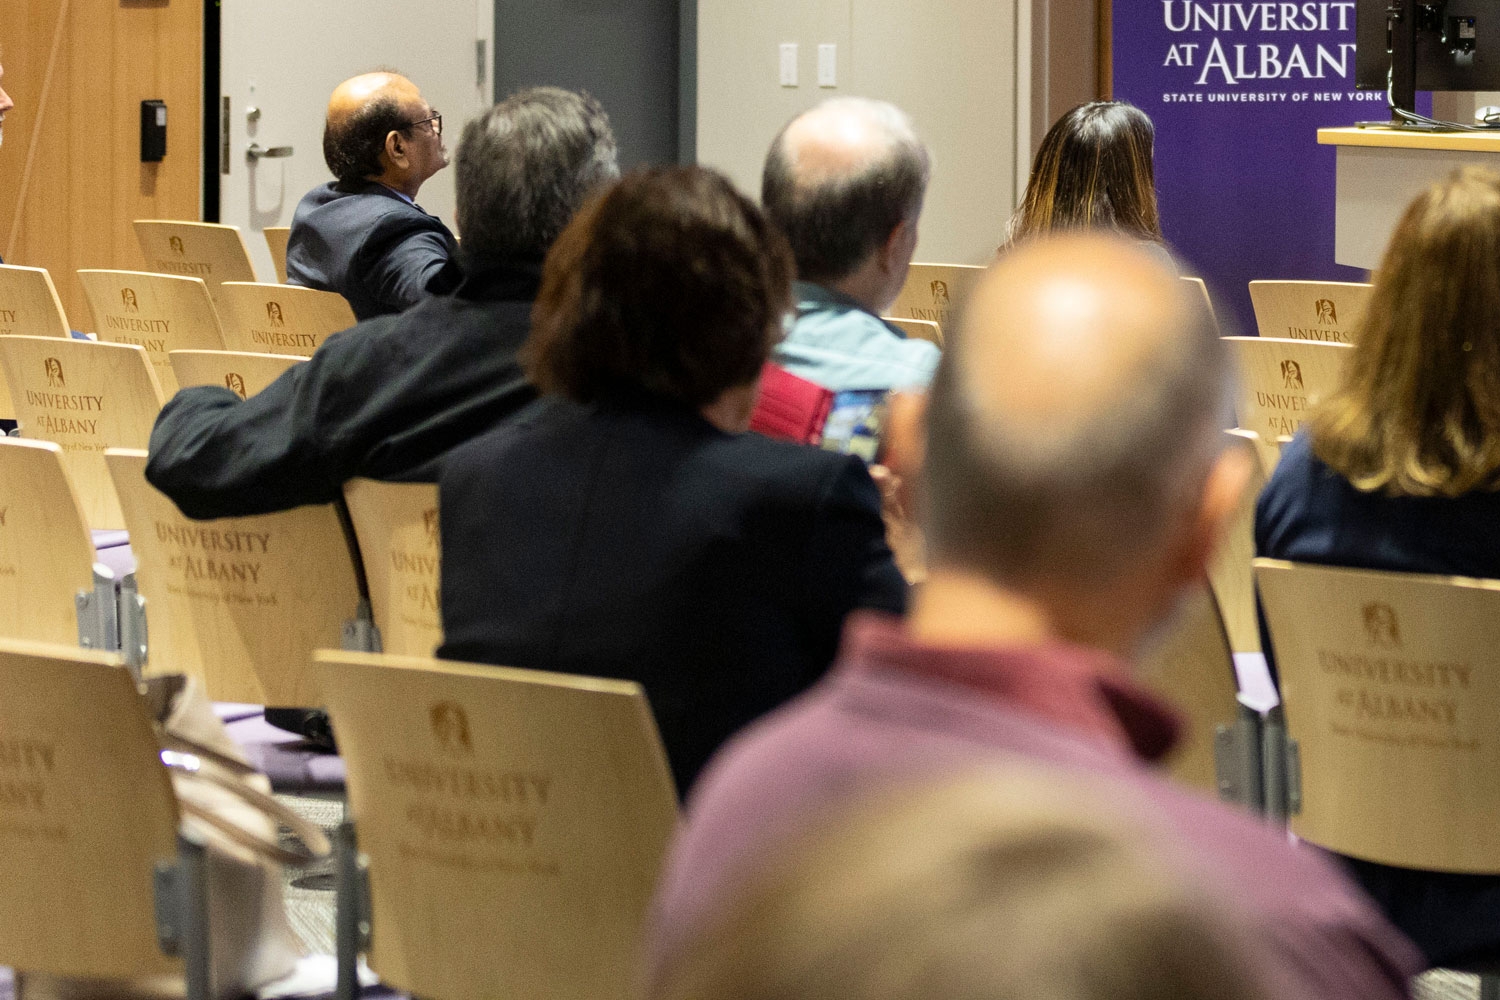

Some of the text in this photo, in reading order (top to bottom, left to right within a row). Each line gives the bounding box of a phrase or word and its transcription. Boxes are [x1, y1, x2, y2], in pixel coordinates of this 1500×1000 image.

[1162, 0, 1355, 31] UNIVERSIT
[1163, 37, 1357, 85] AT ALBAN
[1163, 92, 1383, 102] STATE UNIVERSITY OF NEW YORK
[106, 315, 170, 333] UNIVERSITY
[251, 330, 316, 347] UNIVERSITY
[1288, 327, 1349, 342] UNIVERS
[27, 390, 103, 411] UNIVERSITY
[46, 415, 97, 434] ALBANY
[155, 521, 270, 553] UNIVERSITY
[184, 554, 261, 584] ALBANY
